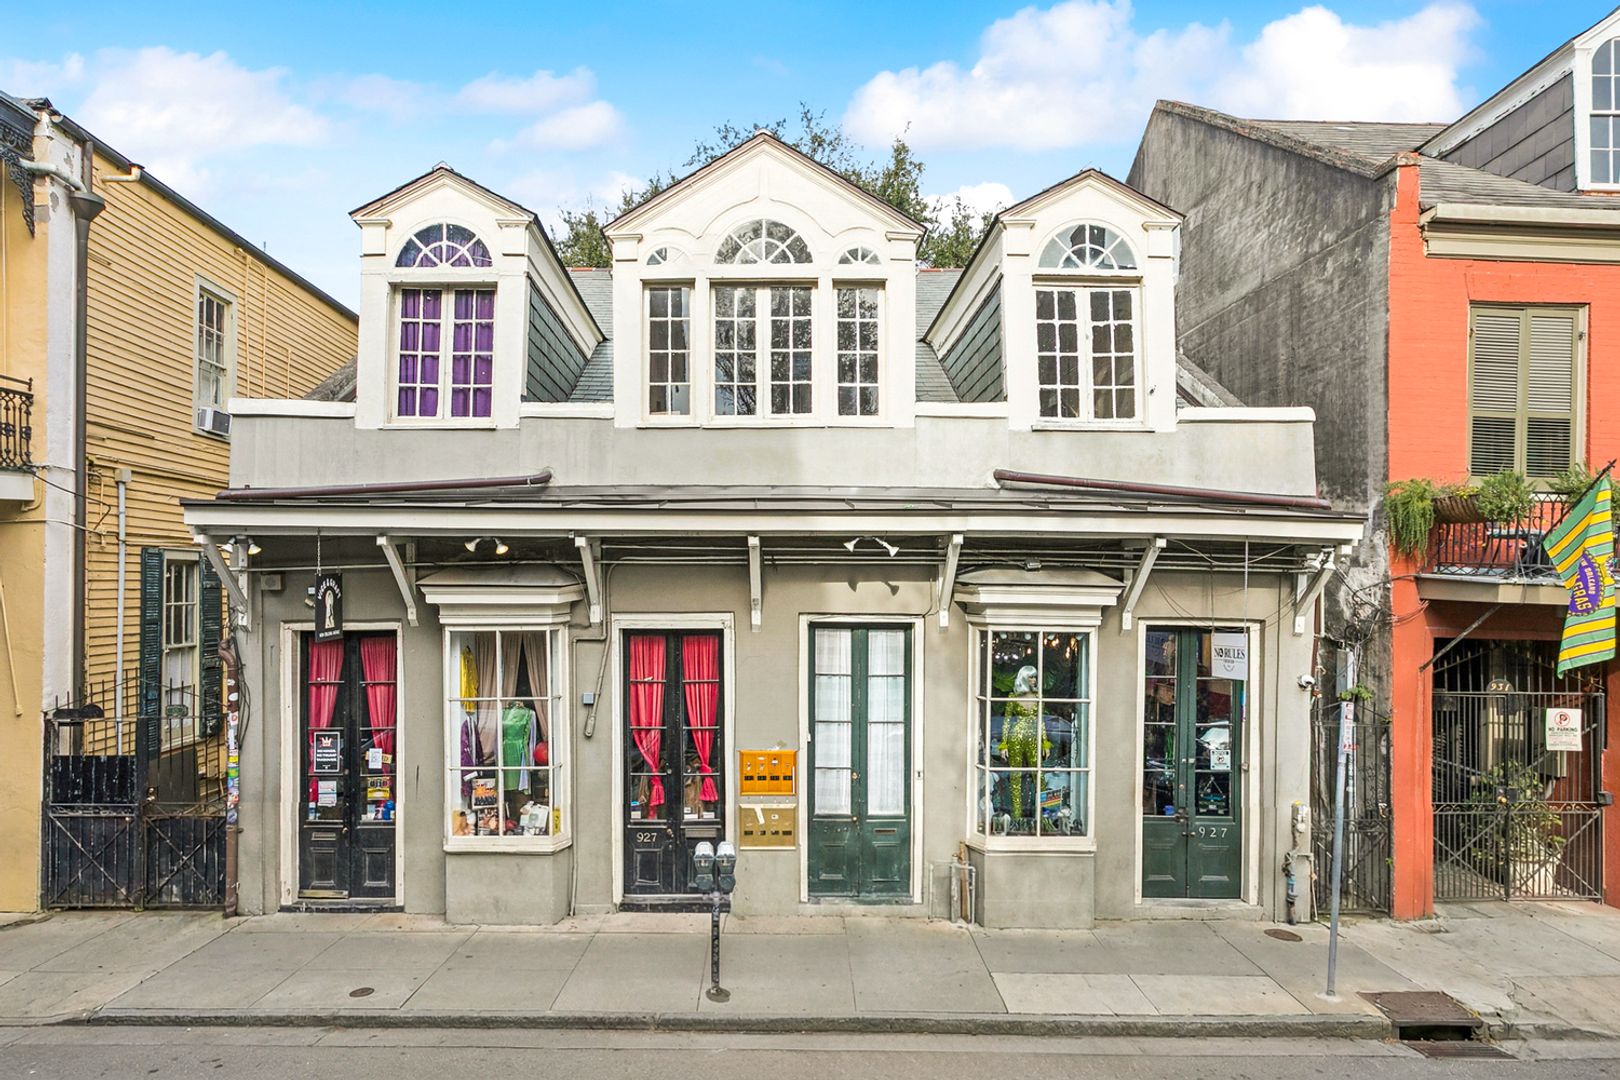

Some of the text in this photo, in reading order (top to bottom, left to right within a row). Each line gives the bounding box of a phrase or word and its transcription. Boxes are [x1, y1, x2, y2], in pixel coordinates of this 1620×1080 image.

[1574, 581, 1592, 611] GRAS
[1213, 647, 1246, 660] NO RULES
[1490, 682, 1510, 691] 931
[636, 832, 658, 843] 927
[1198, 827, 1228, 838] 927
